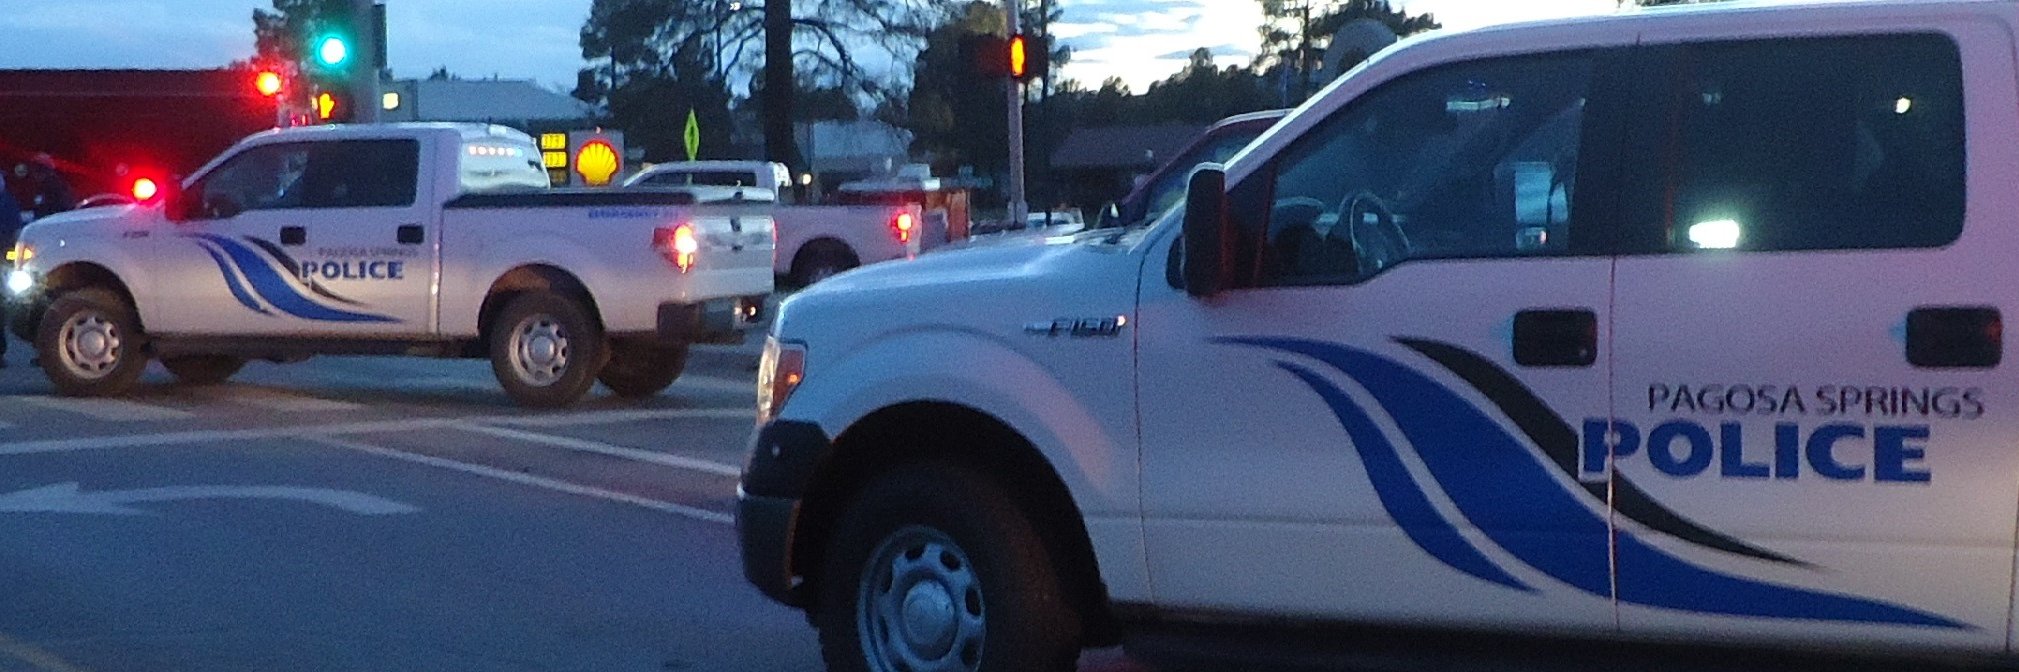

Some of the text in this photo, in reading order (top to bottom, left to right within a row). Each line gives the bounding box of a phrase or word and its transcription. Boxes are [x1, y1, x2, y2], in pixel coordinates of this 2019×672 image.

[302, 261, 404, 279] POLICE
[1647, 384, 1985, 419] PAGOSA SPRINGS
[1582, 417, 1932, 483] POLICE
